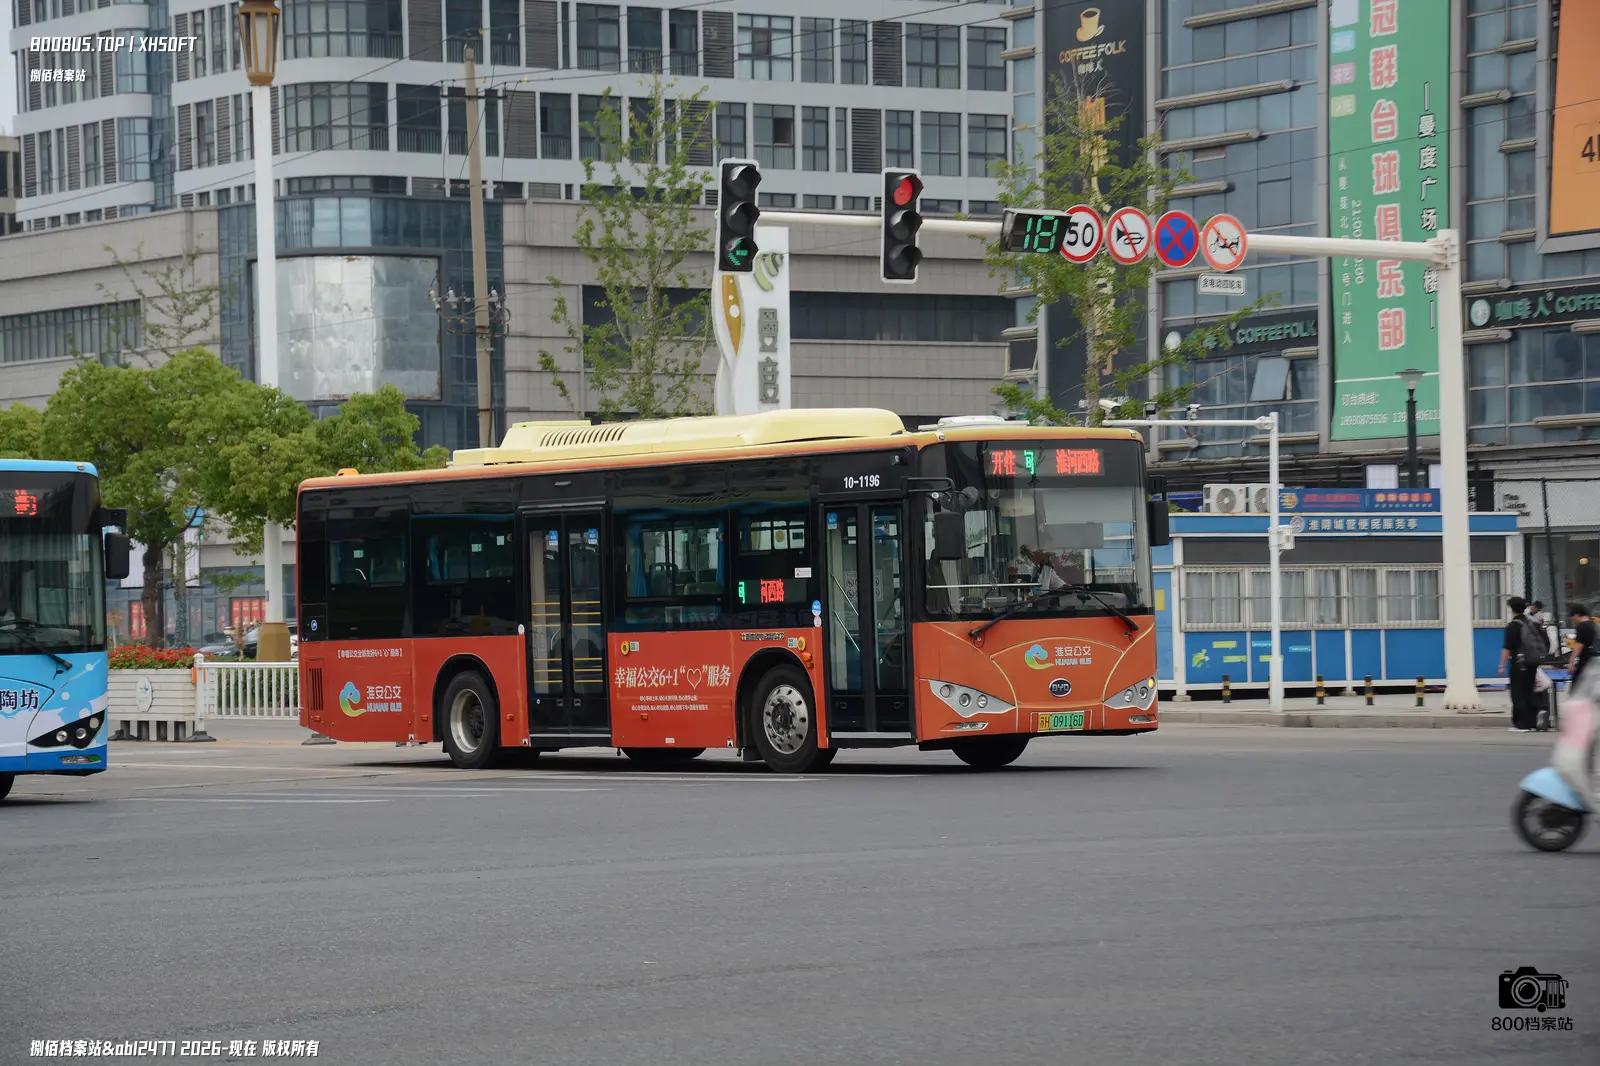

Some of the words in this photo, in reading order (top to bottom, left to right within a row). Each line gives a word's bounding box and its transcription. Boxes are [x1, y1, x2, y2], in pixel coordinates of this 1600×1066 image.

[1023, 214, 1059, 253] 18
[1066, 221, 1096, 247] 50
[1495, 296, 1552, 321] 咖啡人
[1235, 319, 1318, 345] COFFEEFOLK
[991, 449, 1016, 475] 开往
[1055, 448, 1099, 474] 淮河西路
[843, 475, 880, 489] 10-1196
[1055, 646, 1091, 657] 淮安公交
[366, 685, 402, 700] 淮安公交
[1052, 683, 1070, 692] BYD
[1053, 714, 1084, 728] 09116D
